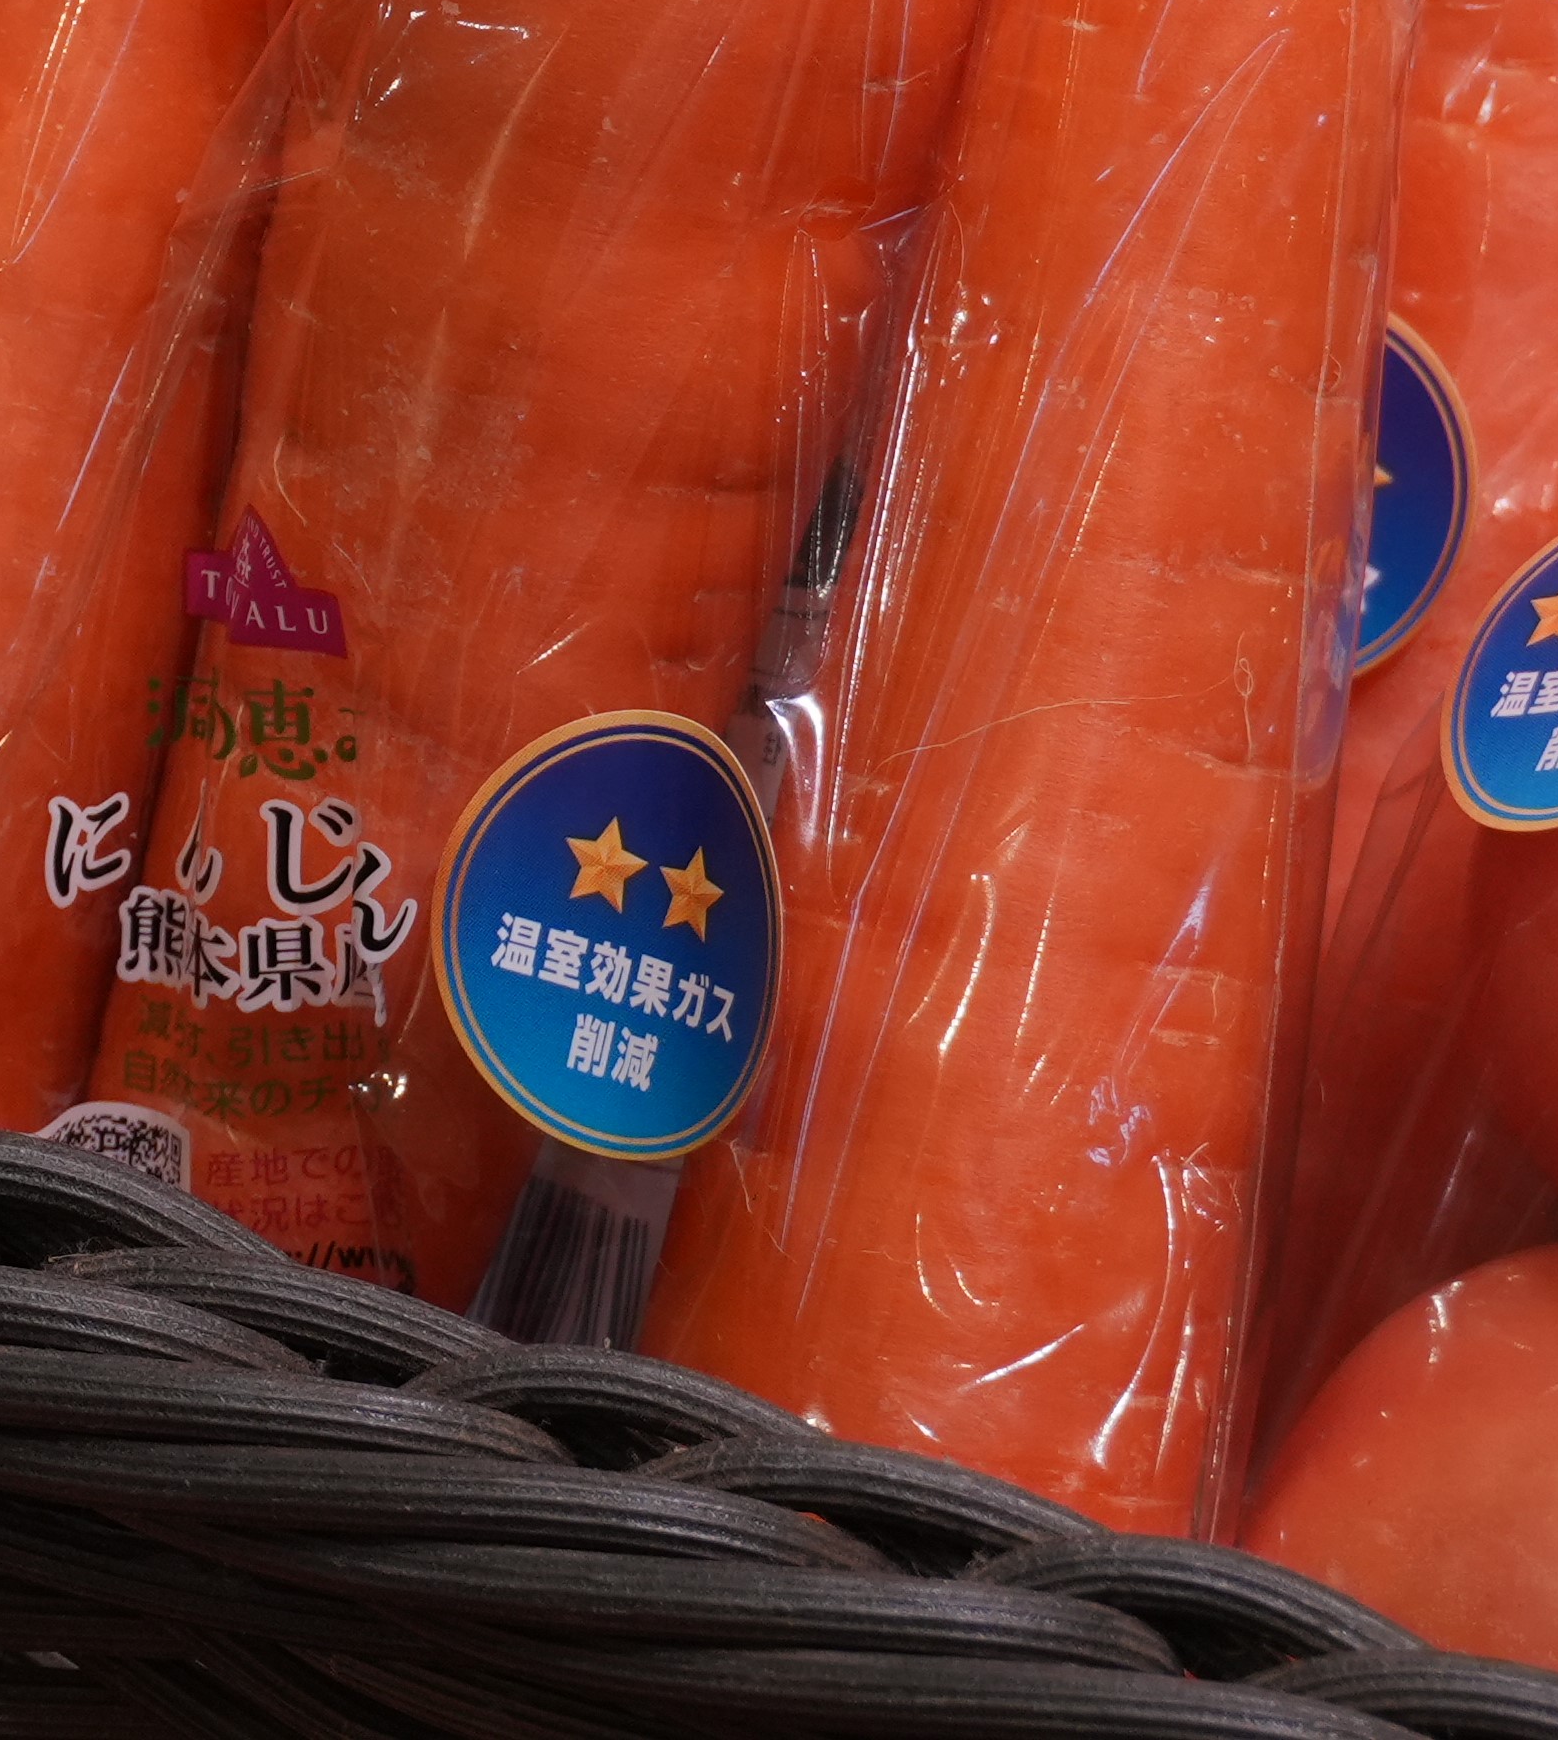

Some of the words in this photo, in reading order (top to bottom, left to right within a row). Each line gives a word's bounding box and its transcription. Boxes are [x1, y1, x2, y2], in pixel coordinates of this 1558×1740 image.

[491, 912, 735, 1043] 温室効果ガス
[566, 1013, 660, 1092] 削減
